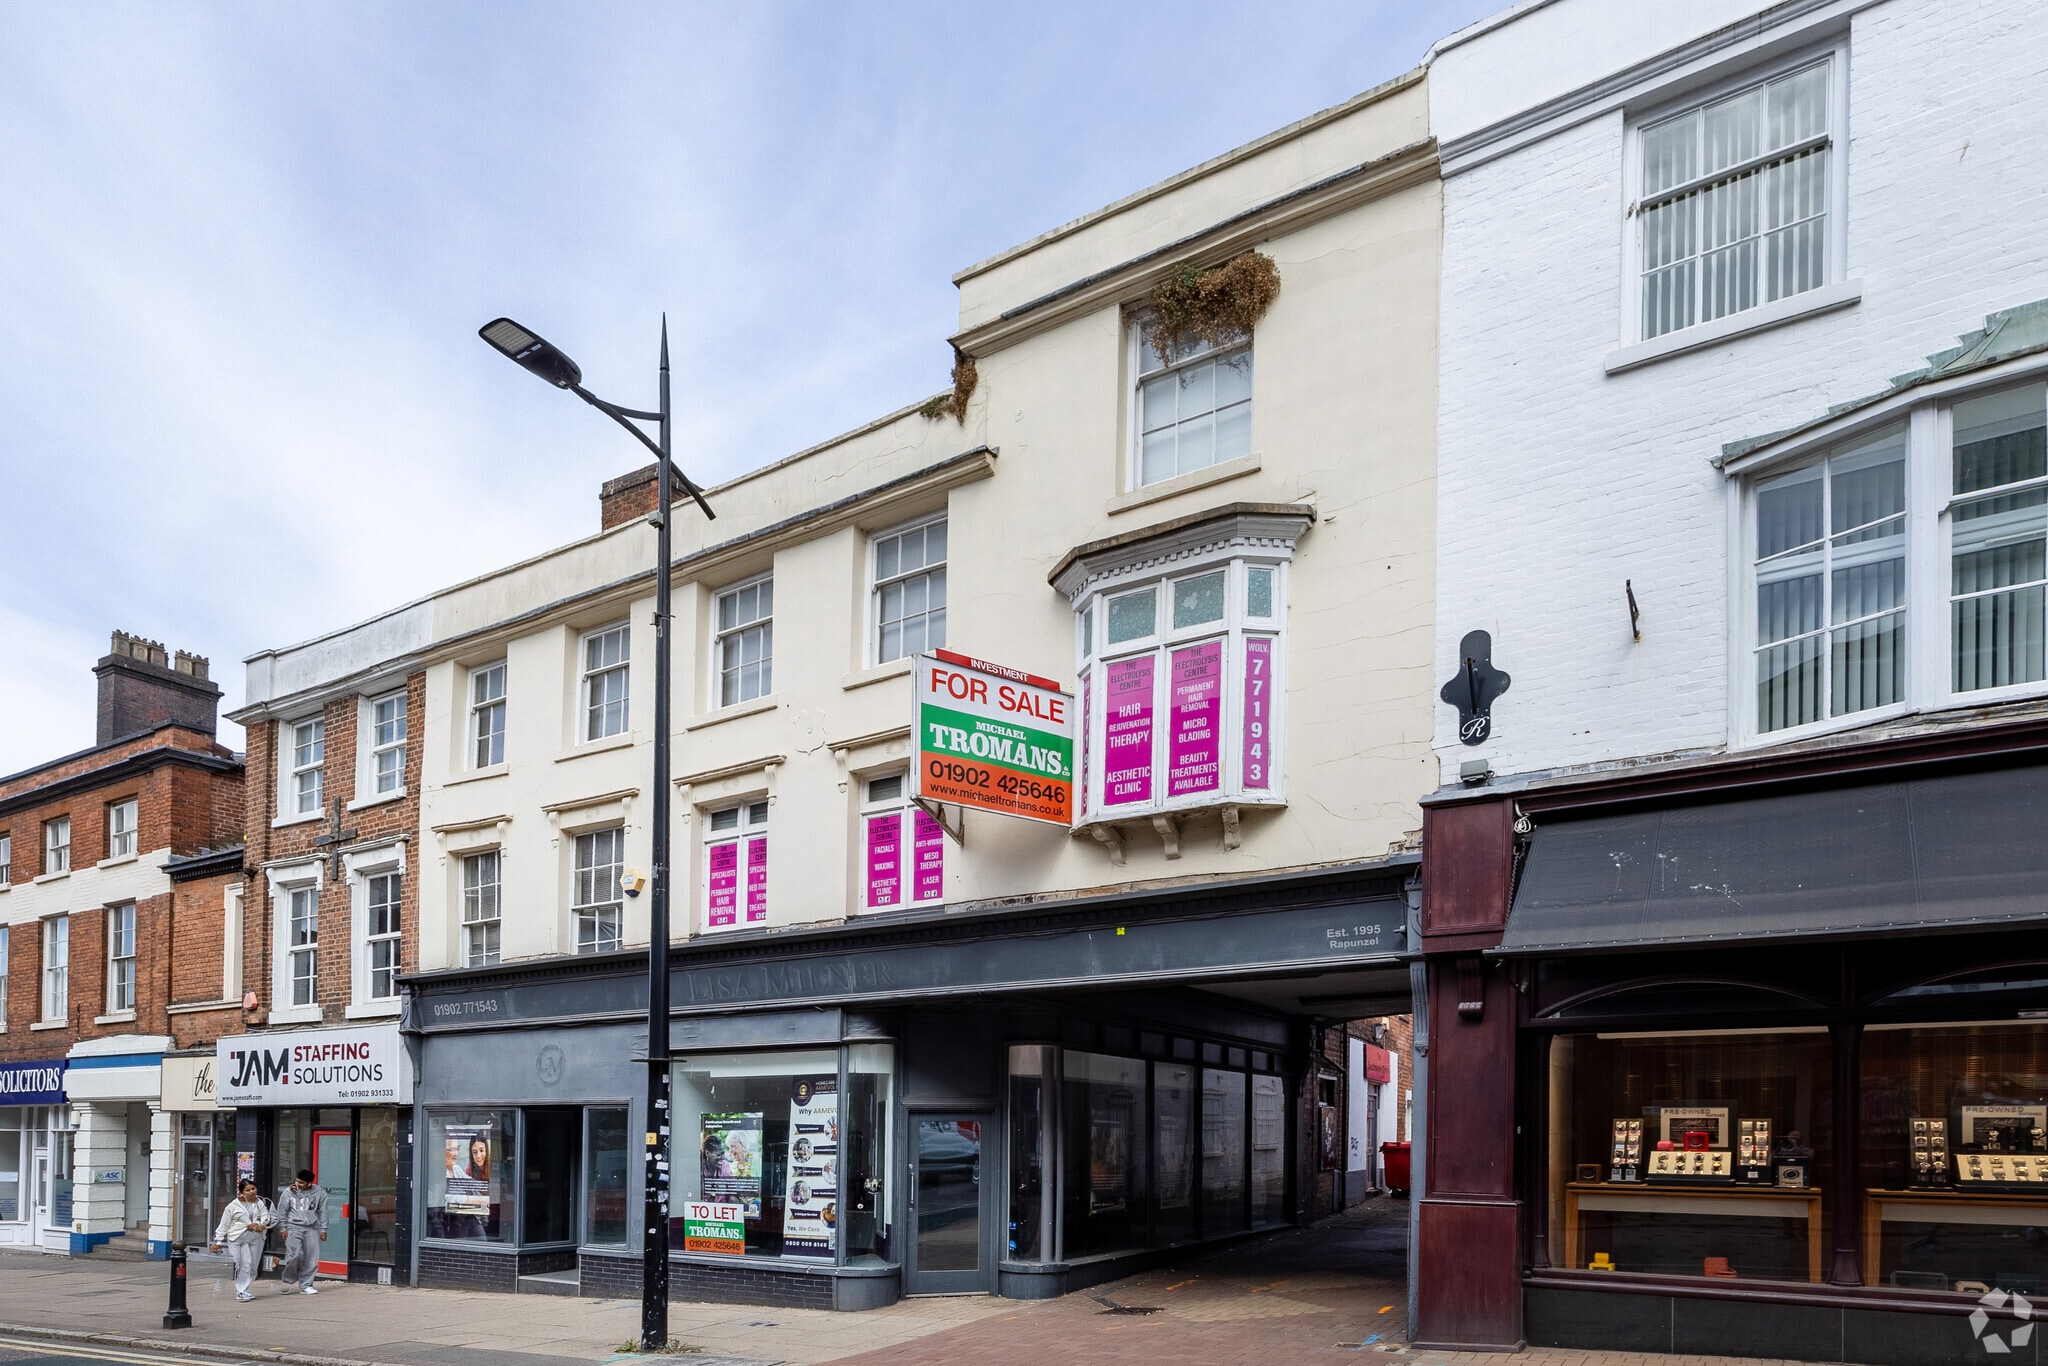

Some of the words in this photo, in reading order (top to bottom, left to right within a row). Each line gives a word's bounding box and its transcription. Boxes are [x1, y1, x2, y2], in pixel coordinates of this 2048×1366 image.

[1190, 648, 1202, 657] THE
[1248, 643, 1269, 652] WOLV.
[1125, 662, 1136, 671] THE
[1175, 654, 1218, 670] ELECTROLYSIS
[970, 659, 1029, 681] INVESTMENT
[1111, 668, 1151, 683] ELECTROLYSIS
[1184, 666, 1208, 678] CENTRE
[1120, 679, 1141, 690] CENTRE
[1177, 681, 1214, 695] PERMANENT
[931, 668, 988, 704] FOR
[998, 685, 1065, 724] SALE
[1188, 692, 1203, 703] HAIR
[1119, 703, 1141, 717] HAIR
[1181, 701, 1210, 713] REMOVAL
[1109, 717, 1150, 732] REJUVENATION
[1183, 717, 1206, 730] MICRO
[1461, 716, 1490, 740] R
[976, 721, 1027, 740] MICHAEL
[1179, 729, 1210, 743] BLADING
[1110, 730, 1149, 748] THERAPY
[929, 723, 1062, 775] TROMANS
[1180, 751, 1208, 765] BEAUTY
[1107, 766, 1150, 783] AESTHETIC
[1171, 762, 1217, 779] TREATMENTS
[929, 760, 990, 788] 01902
[997, 775, 1065, 803] 425646
[1114, 781, 1141, 795] CLINIC
[1174, 775, 1213, 790] AVAILABLE
[930, 783, 1065, 817] www.michaeltromans.co.uk
[870, 823, 899, 834] ELECTROLYSIS
[876, 832, 892, 840] CENTRE
[875, 845, 894, 854] FACIALS
[924, 852, 939, 860] MESO
[875, 862, 894, 871] WAXING
[920, 860, 942, 870] THERAPY
[711, 870, 736, 879] SPECIALISTS
[923, 876, 940, 884] LASER
[872, 878, 897, 888] AESTHETIC
[711, 887, 736, 896] PERMANENT
[876, 887, 892, 896] CLINIC
[716, 896, 729, 905] HAIR
[711, 905, 735, 916] REMOVAL
[1326, 928, 1348, 938] Est.
[1353, 925, 1381, 935] 1995
[1330, 937, 1378, 949] Rapunzel
[434, 1003, 461, 1016] 01902
[463, 1000, 498, 1013] 771543
[294, 1043, 369, 1062] STAFFING
[194, 1062, 216, 1097] the
[294, 1064, 382, 1084] SOLUTIONS
[350, 1090, 369, 1098] 01902
[370, 1089, 393, 1097] 931333
[799, 1108, 812, 1116] Why
[105, 1171, 120, 1179] ASC
[691, 1205, 709, 1218] TO
[714, 1206, 737, 1220] LET
[689, 1226, 740, 1239] TROMANS
[689, 1239, 711, 1248] 01902
[713, 1241, 741, 1251] 425646
